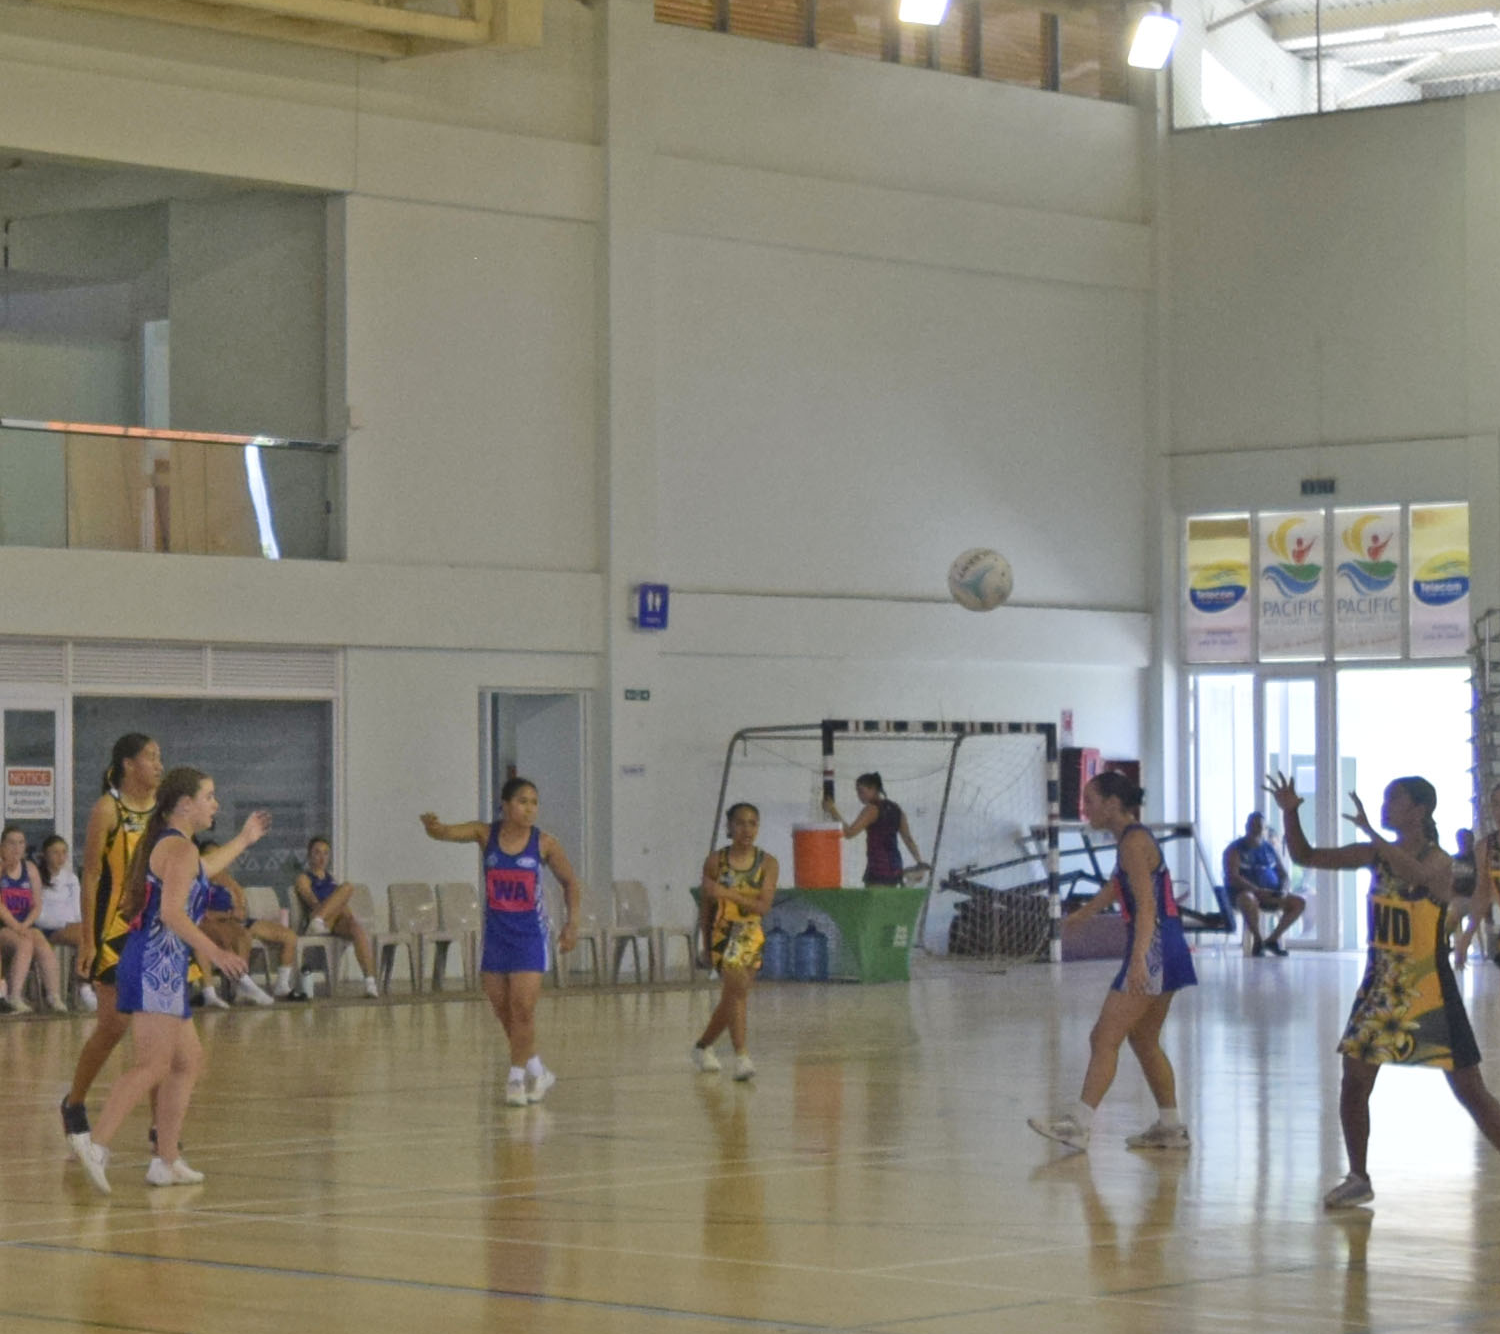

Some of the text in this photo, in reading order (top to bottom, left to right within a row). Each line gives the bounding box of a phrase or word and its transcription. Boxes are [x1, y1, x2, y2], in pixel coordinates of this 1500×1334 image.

[1263, 598, 1322, 617] PACIFIC
[1337, 596, 1397, 615] PACIFIC
[493, 878, 529, 901] WA
